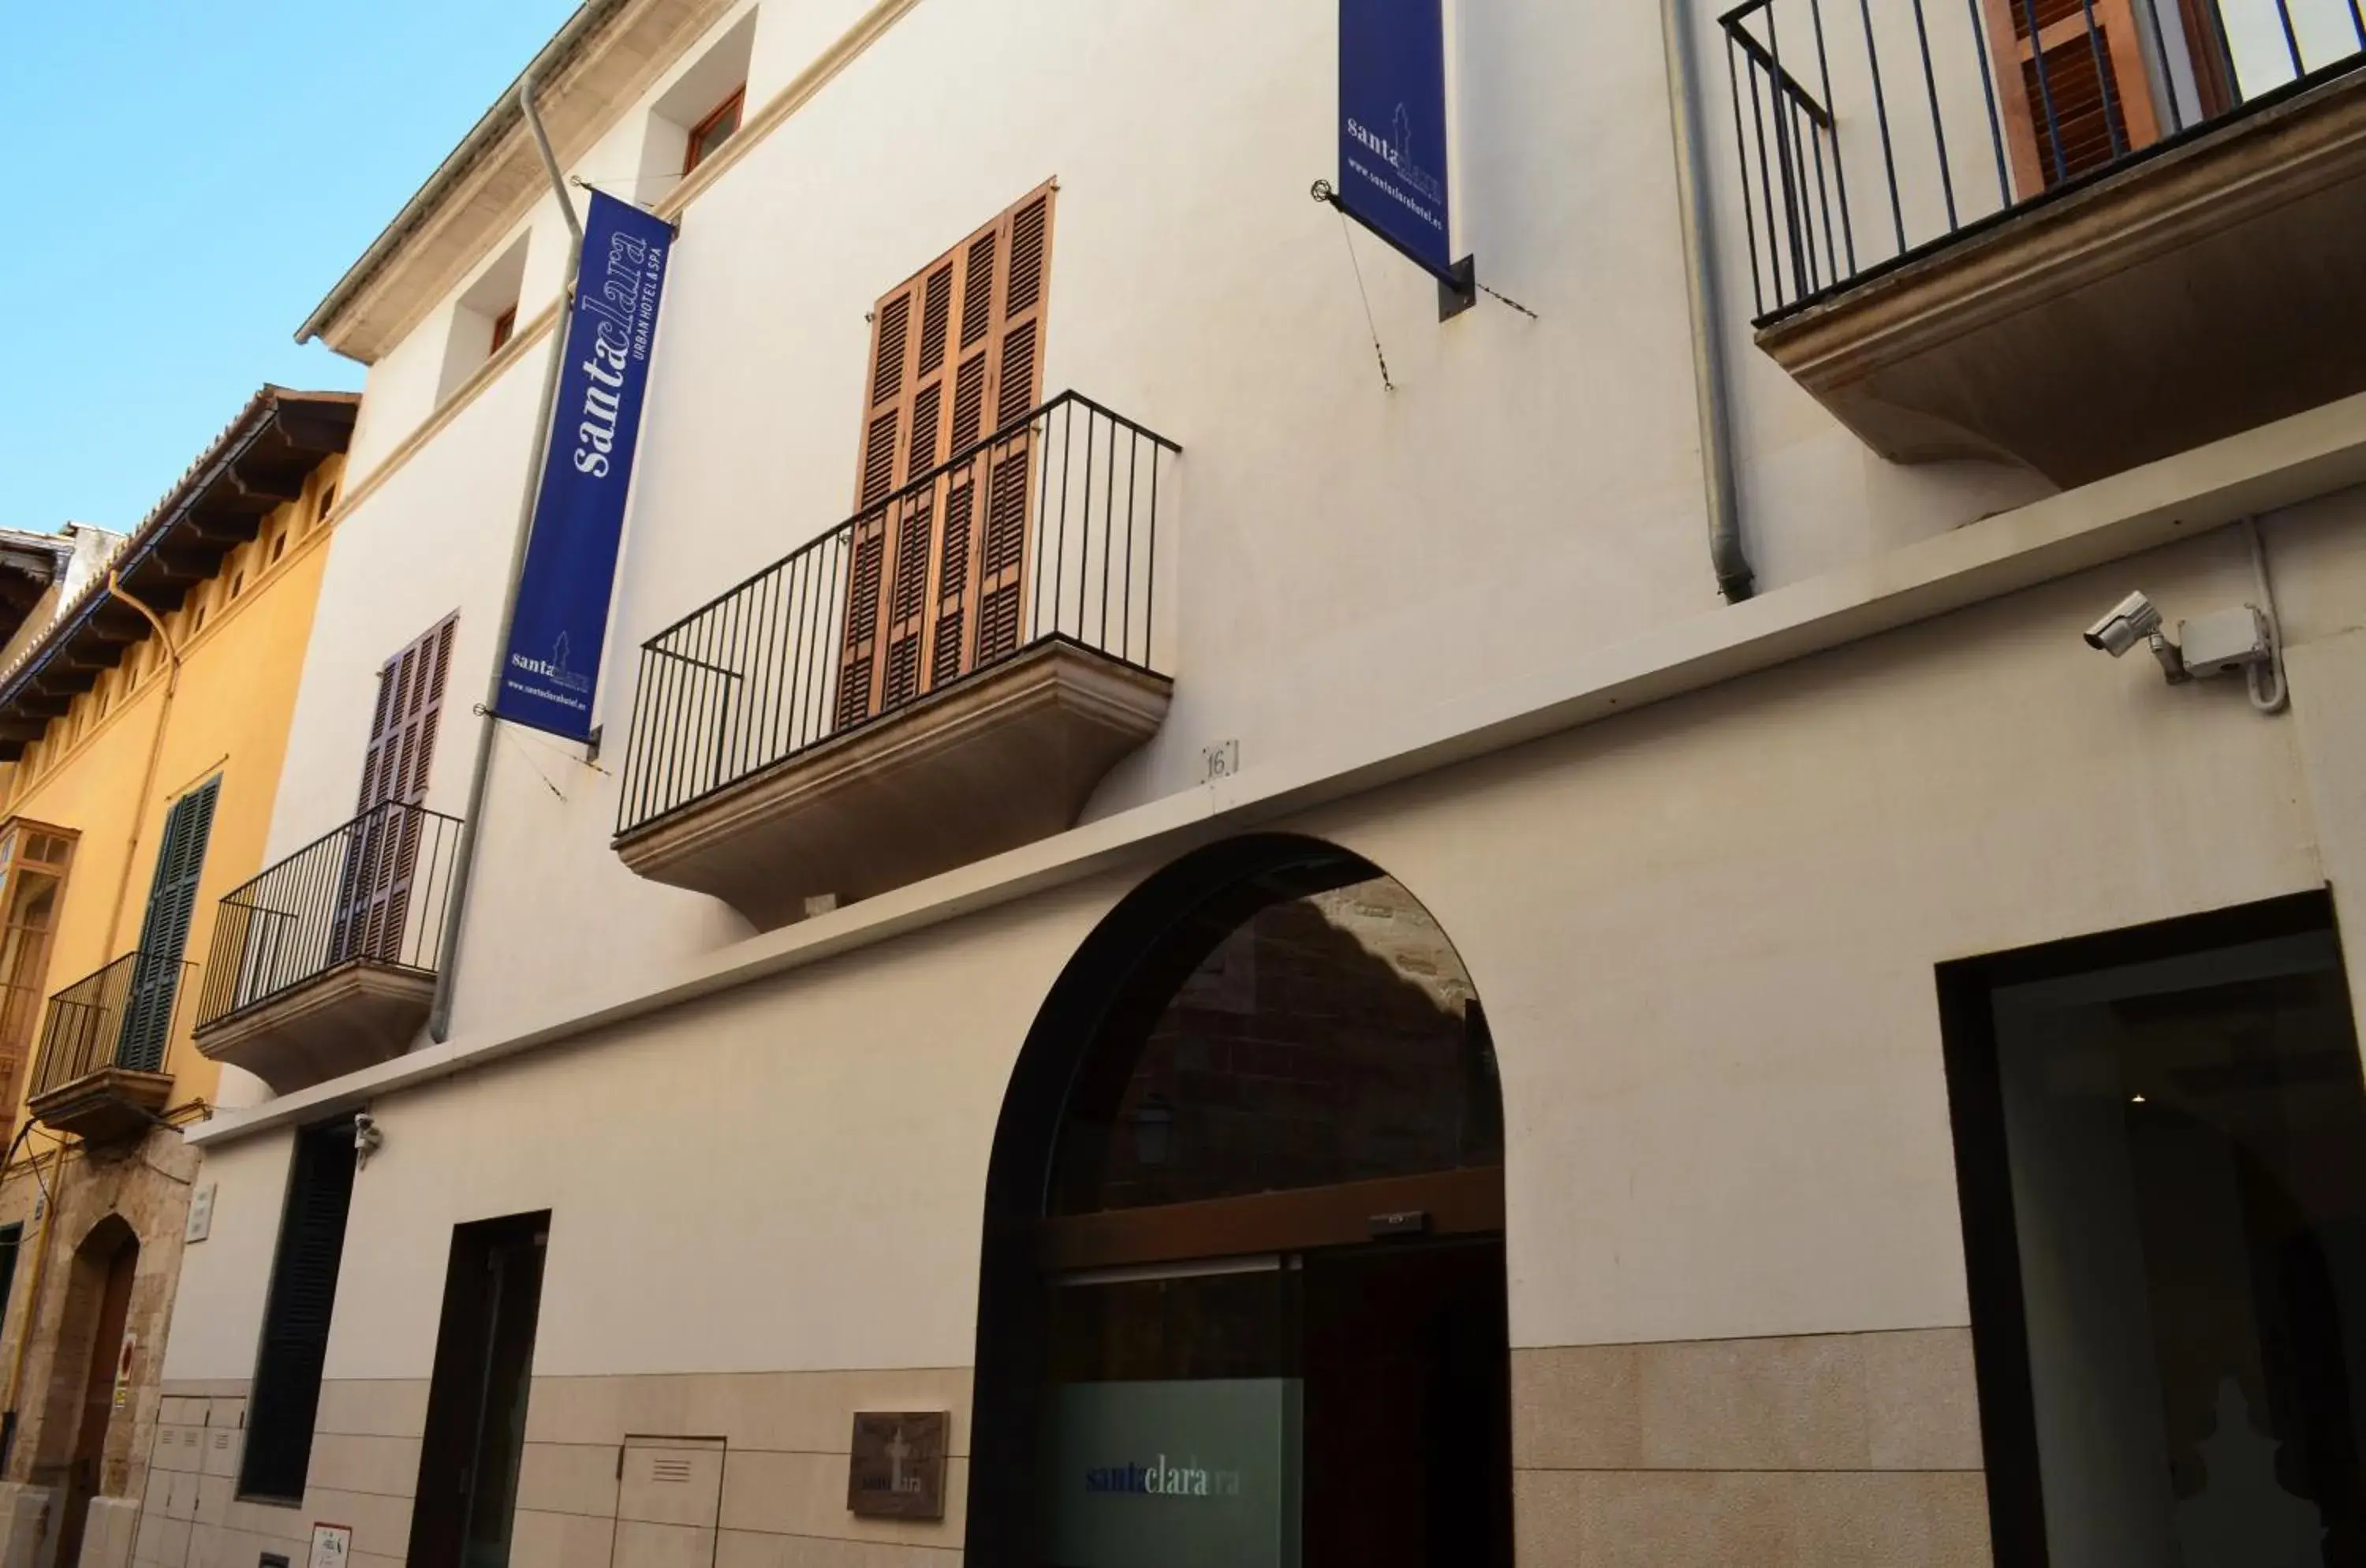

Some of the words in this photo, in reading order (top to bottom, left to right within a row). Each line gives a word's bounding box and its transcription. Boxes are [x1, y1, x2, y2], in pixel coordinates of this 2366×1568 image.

[647, 248, 663, 271] SPA
[640, 282, 658, 320] HOTEL
[633, 319, 651, 360] URBAN
